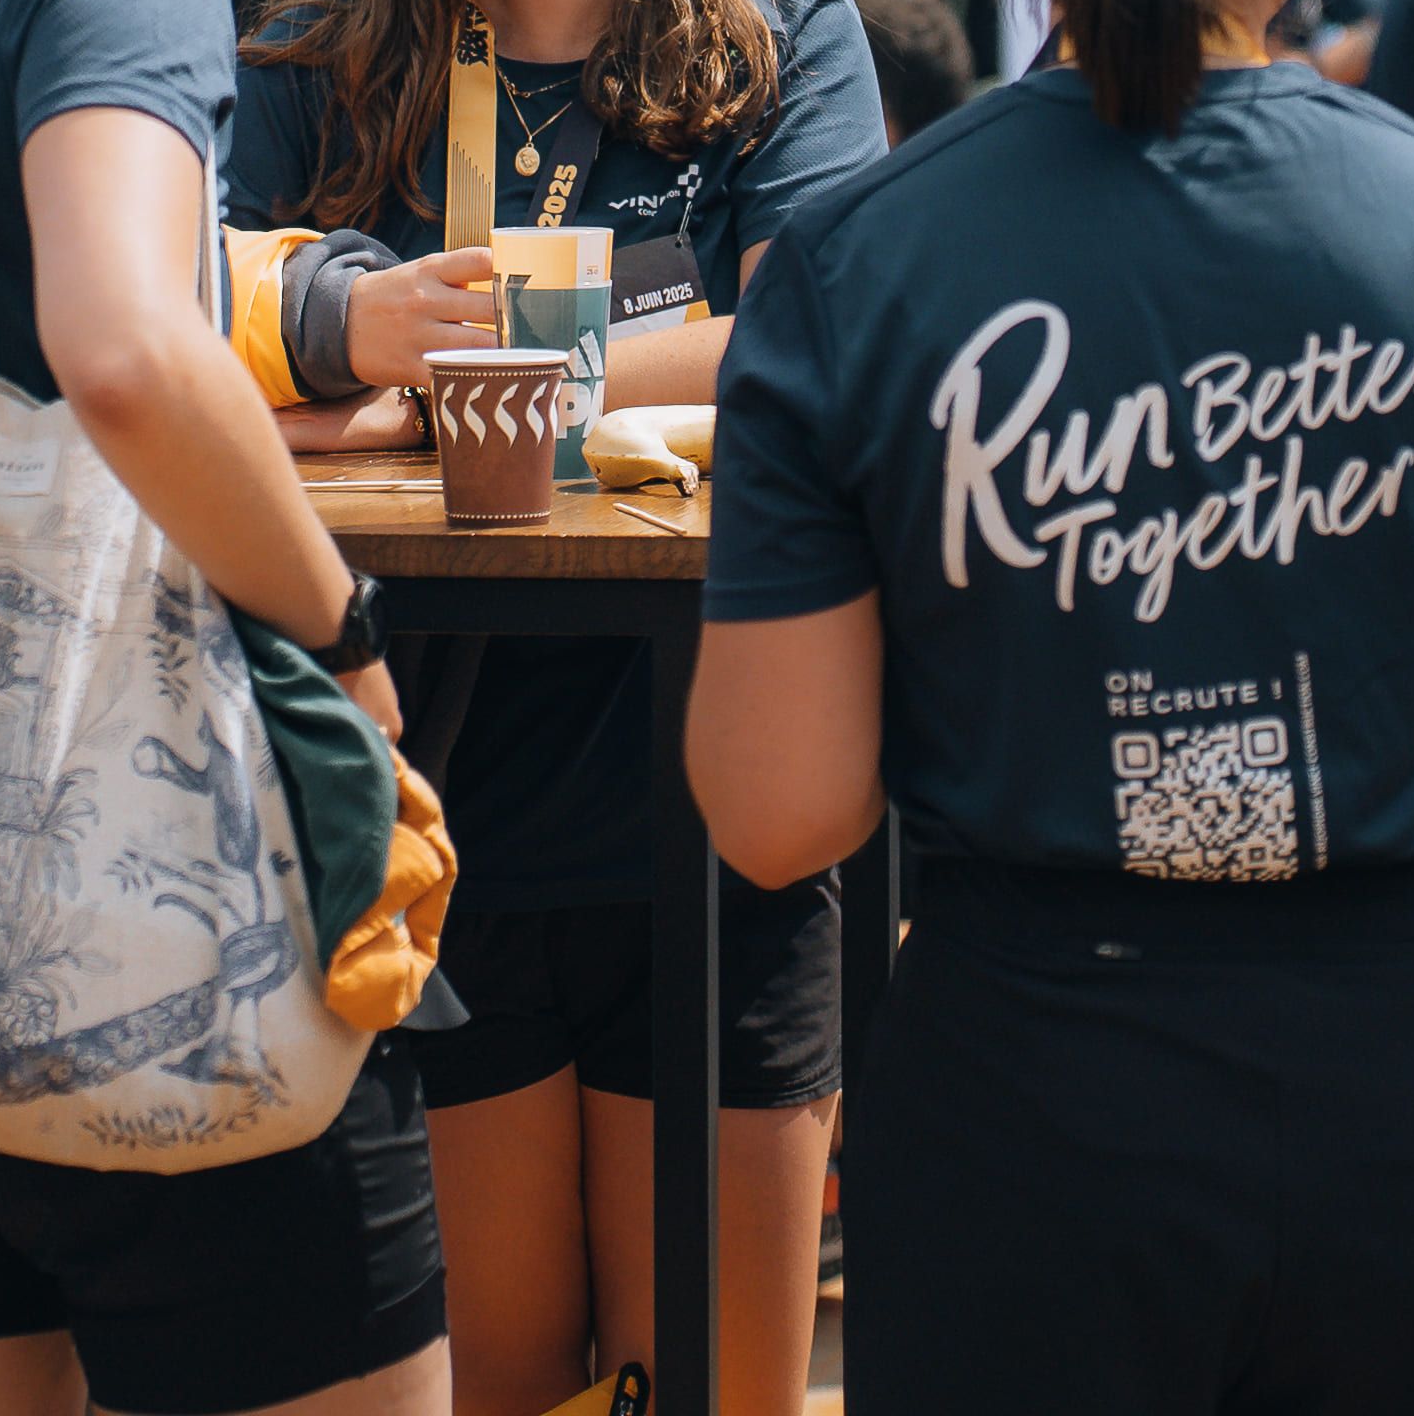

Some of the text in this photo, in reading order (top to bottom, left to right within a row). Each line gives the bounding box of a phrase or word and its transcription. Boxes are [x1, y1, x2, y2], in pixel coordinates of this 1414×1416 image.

[537, 163, 578, 227] 2025
[623, 282, 694, 315] 8 JUIN 2025
[929, 298, 1175, 589] Run
[1034, 434, 1414, 624] Together
[1105, 671, 1154, 694] ON
[1106, 682, 1260, 717] RECRUTE
